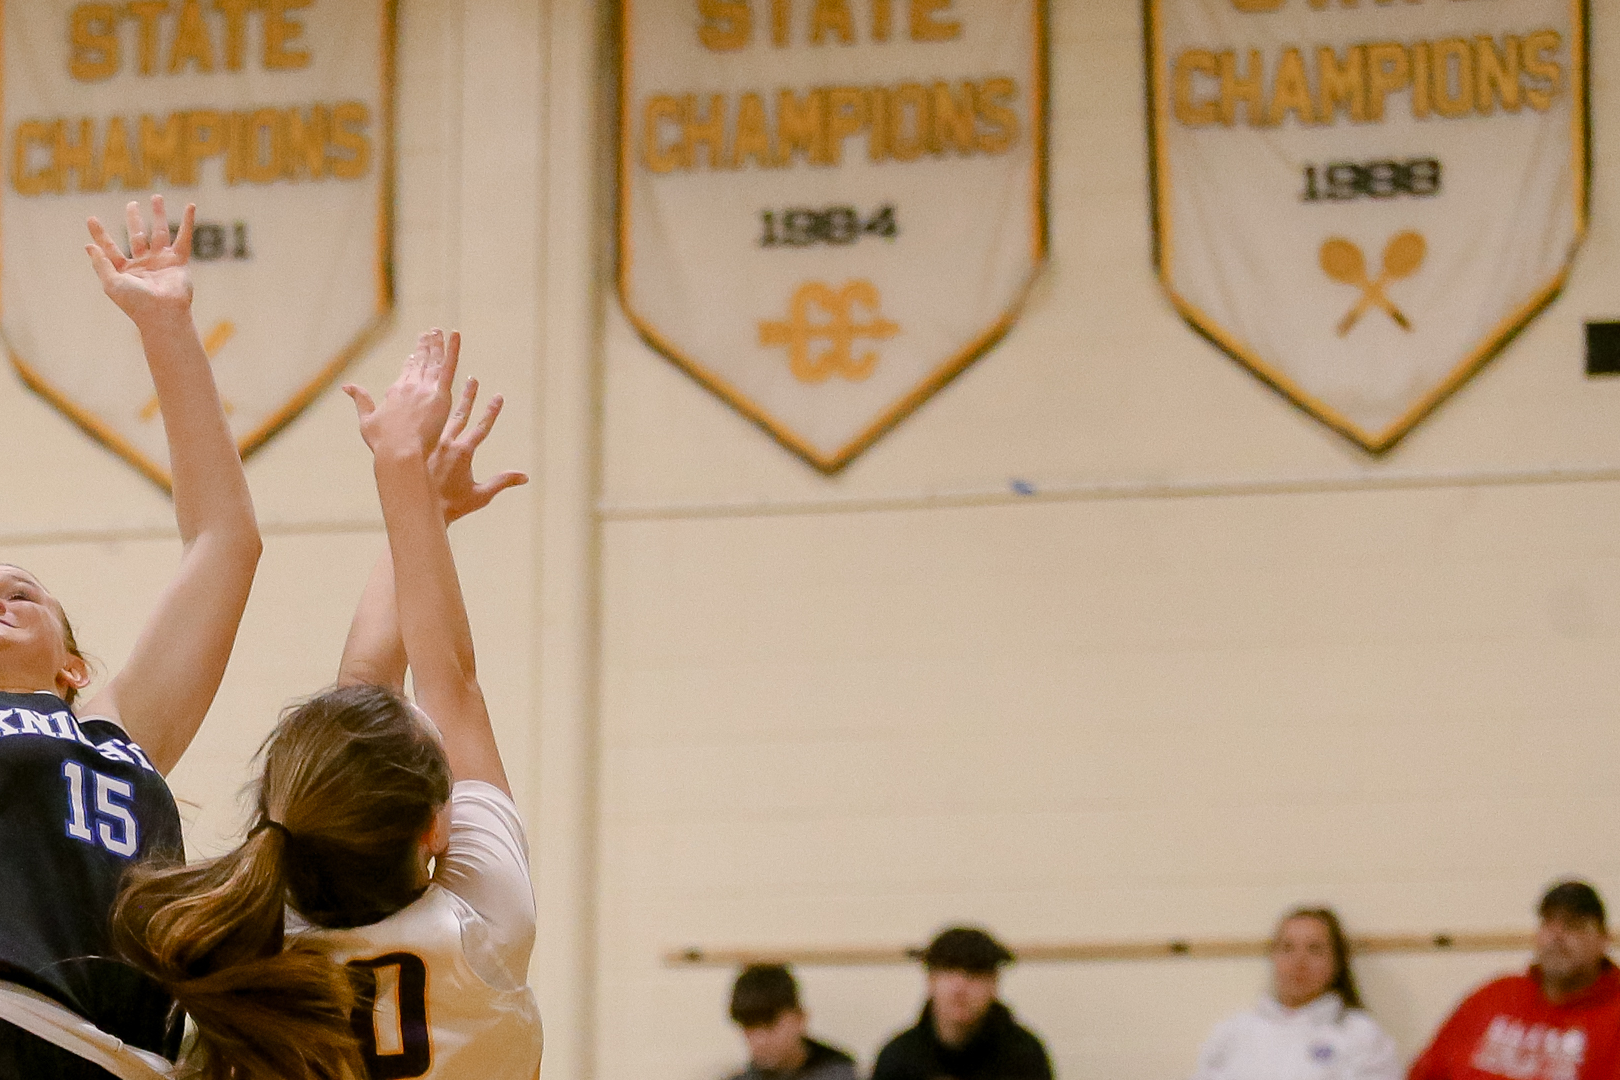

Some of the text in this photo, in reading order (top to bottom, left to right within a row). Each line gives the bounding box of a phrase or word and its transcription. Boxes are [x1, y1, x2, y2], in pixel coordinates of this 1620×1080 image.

[68, 0, 315, 81] STATE
[1172, 29, 1564, 128] CHAMPIONS
[10, 102, 372, 197] CHAMPIONS
[641, 76, 1021, 173] CHAMPIONS
[757, 204, 898, 248] 1984
[1300, 156, 1442, 202] 1988
[60, 757, 142, 861] 15
